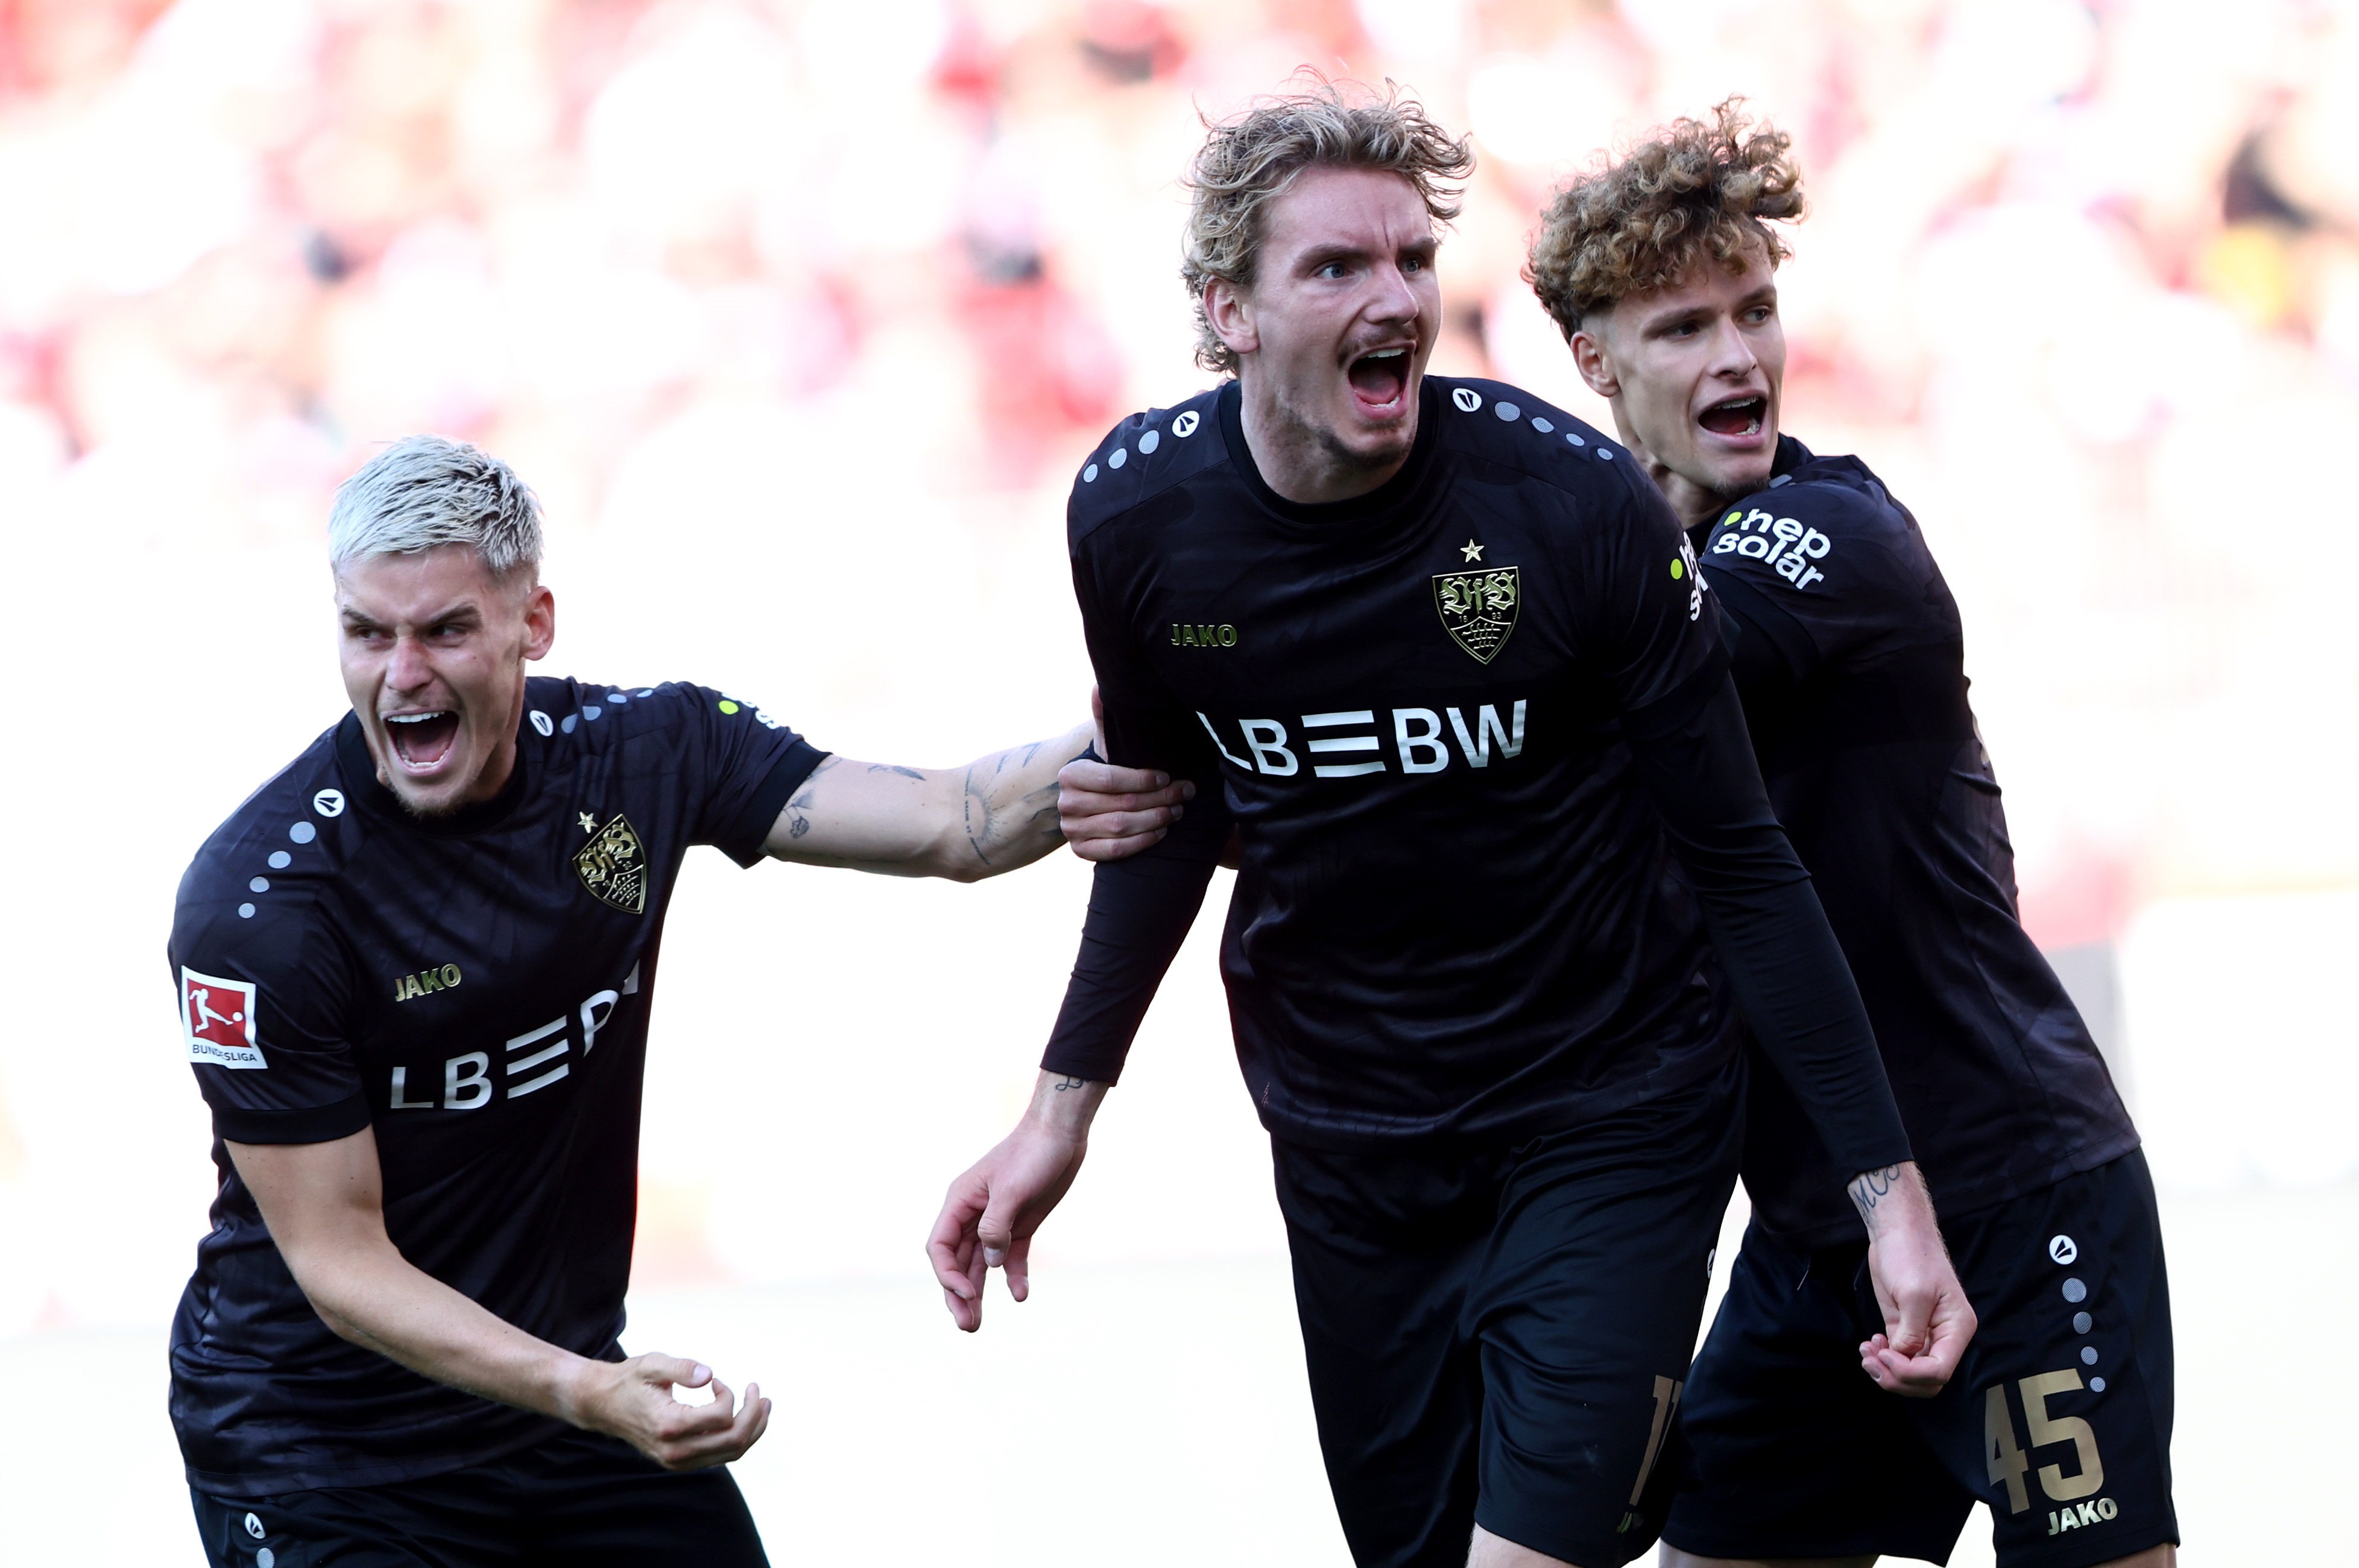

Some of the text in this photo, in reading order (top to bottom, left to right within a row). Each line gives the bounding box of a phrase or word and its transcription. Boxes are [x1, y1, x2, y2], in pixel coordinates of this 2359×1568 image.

[1740, 508, 1831, 558] nep
[1713, 533, 1824, 590] solar
[1171, 624, 1237, 647] JAKO
[394, 963, 462, 1002] JAKO
[1985, 1368, 2104, 1514] 45
[2048, 1497, 2118, 1535] JAKO
